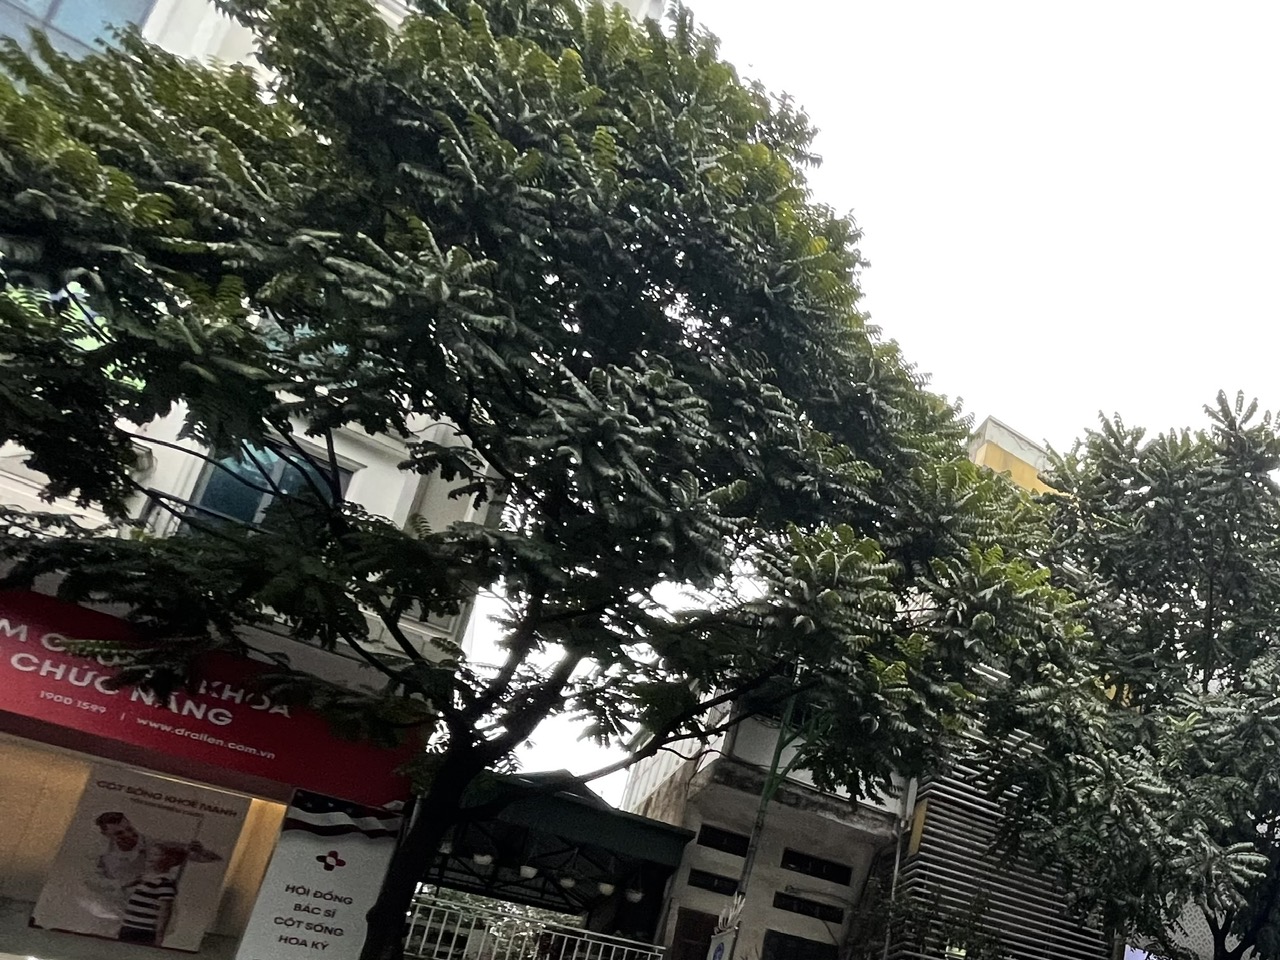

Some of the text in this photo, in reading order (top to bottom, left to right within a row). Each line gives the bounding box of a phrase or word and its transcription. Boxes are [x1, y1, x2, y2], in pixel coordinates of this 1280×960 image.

[40, 690, 73, 705] 1900
[76, 700, 107, 714] 1599
[285, 884, 311, 897] HỘI
[293, 902, 322, 916] BÁC
[274, 916, 304, 930] CỘT
[279, 935, 308, 948] HOA
